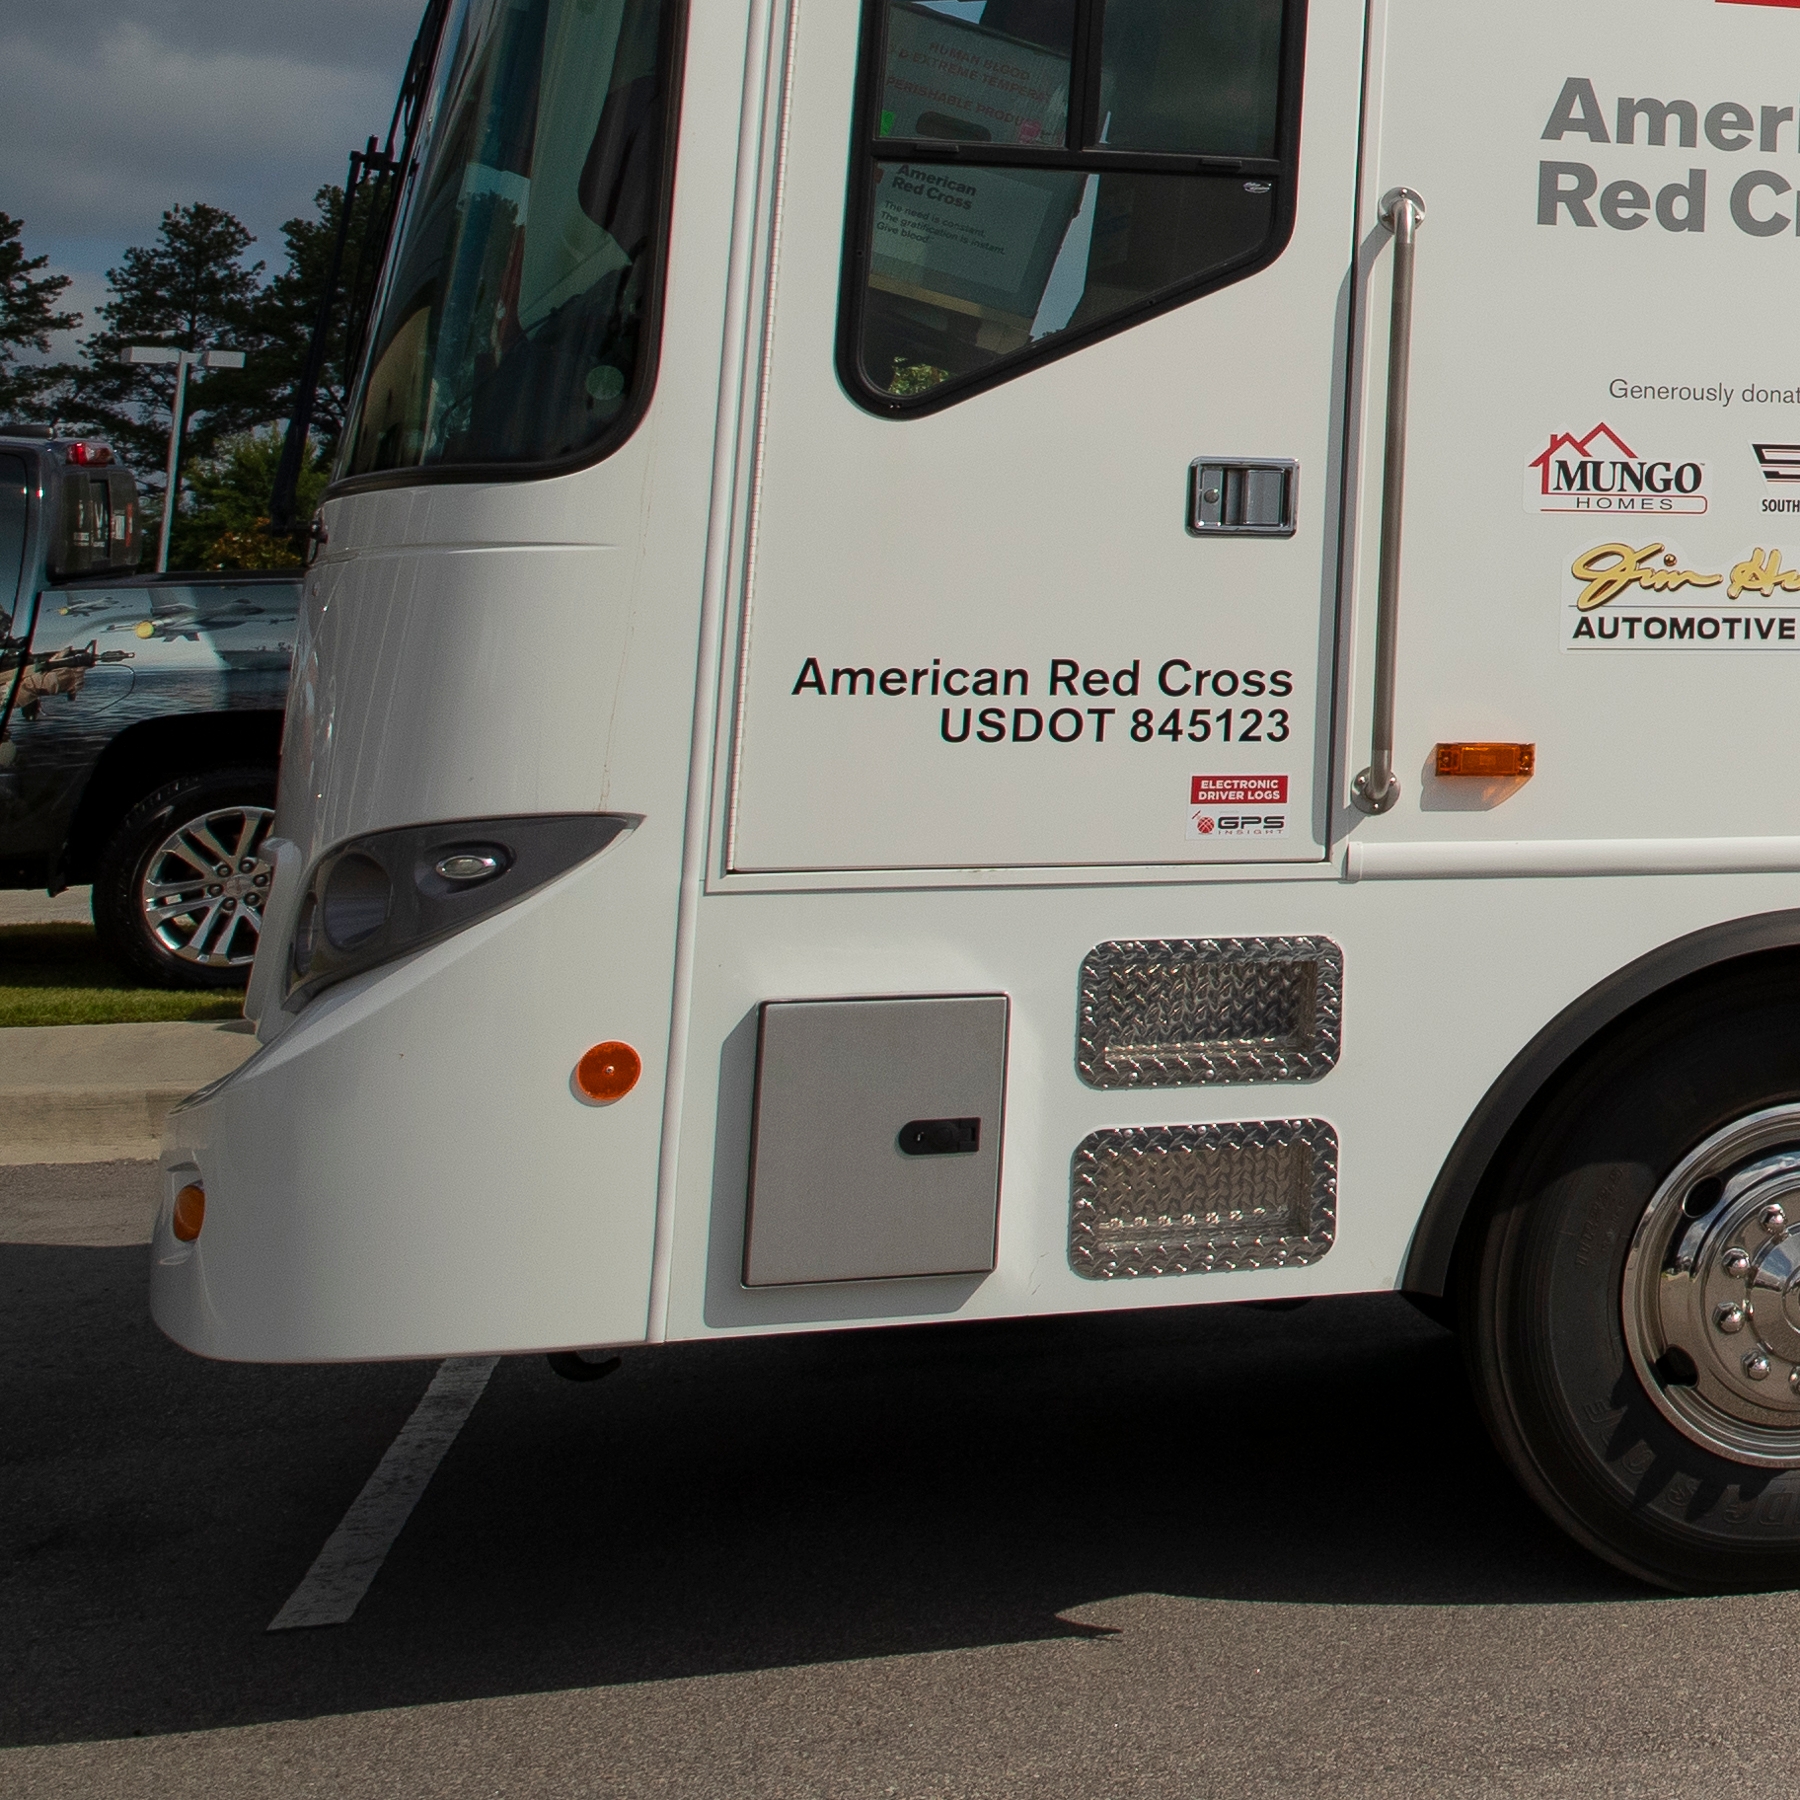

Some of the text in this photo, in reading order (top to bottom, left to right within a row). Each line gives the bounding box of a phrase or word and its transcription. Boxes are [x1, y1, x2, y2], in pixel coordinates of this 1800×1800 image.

[912, 52, 978, 80] EXTREME
[930, 42, 980, 66] HUMAN
[983, 58, 1031, 81] BLOOD
[975, 103, 1028, 127] PRODU
[891, 176, 973, 211] Red Cross
[897, 163, 978, 197] American
[1537, 161, 1706, 232] Red
[884, 200, 904, 213] The
[904, 207, 930, 221] need
[930, 214, 940, 224] is
[876, 221, 899, 235] Give
[880, 211, 899, 224] The
[900, 216, 959, 242] gratification
[960, 234, 970, 244] is
[1608, 378, 1734, 408] Generously
[1552, 459, 1703, 494] MUNGO
[1576, 496, 1673, 511] HOMES
[1571, 542, 1723, 612] Jim
[1571, 615, 1796, 641] AUTOMOTIVE
[790, 656, 1294, 698] American Red Cross
[939, 707, 1290, 744] USDOT 845123
[1198, 790, 1280, 801] DRIVER LOGS
[1200, 779, 1279, 790] ELECTRONIC
[1217, 815, 1285, 830] GPS
